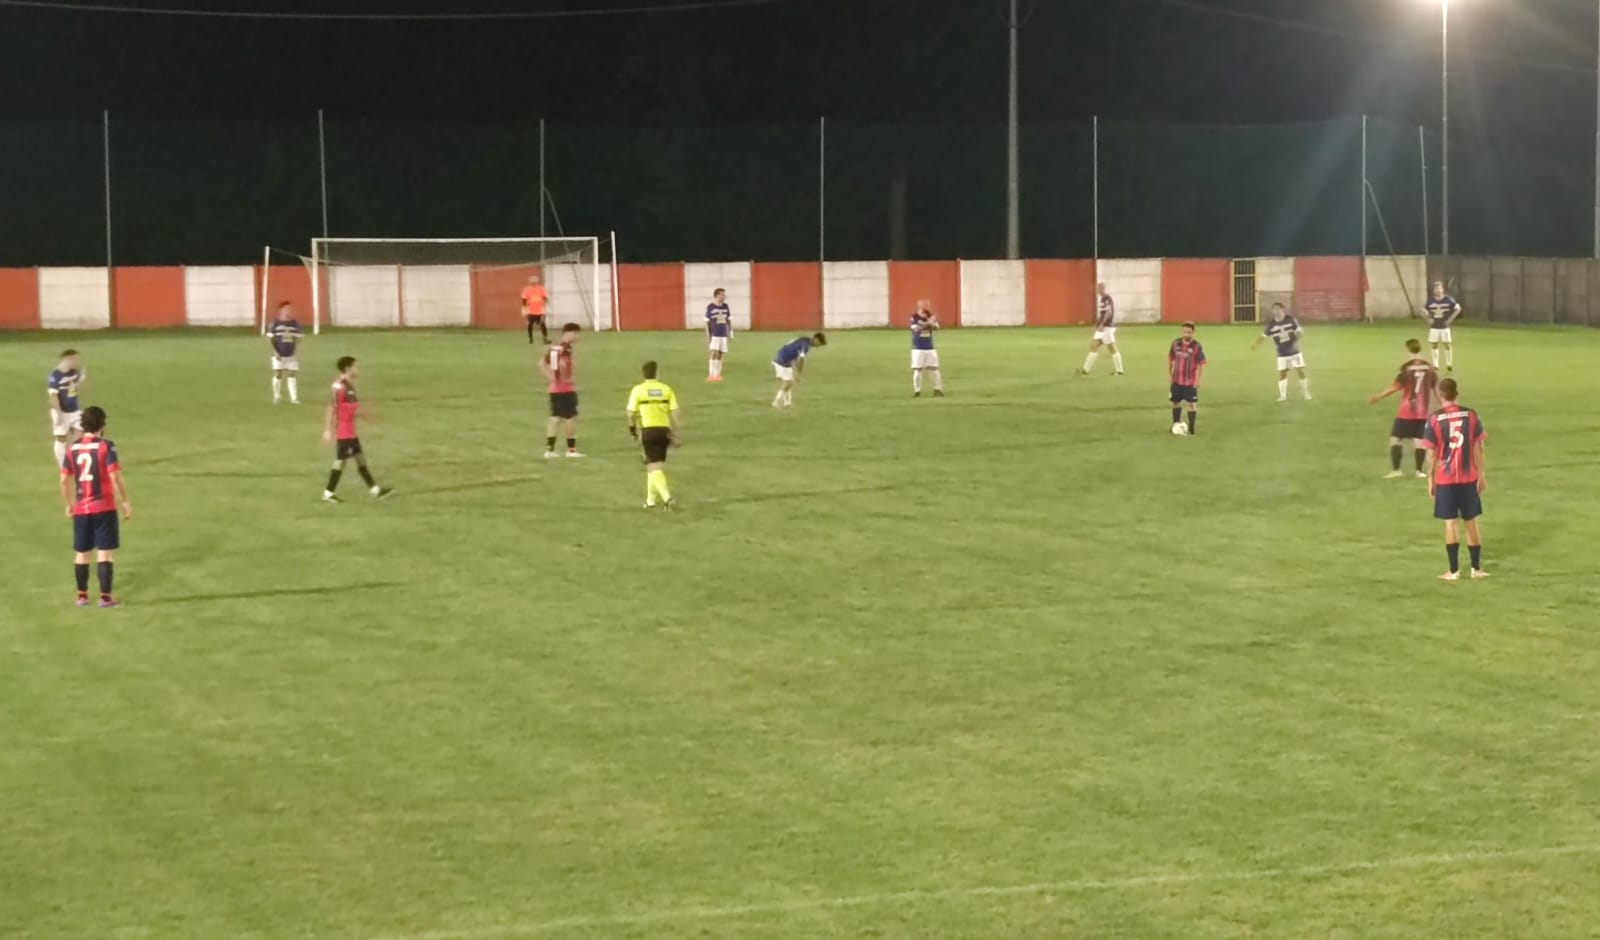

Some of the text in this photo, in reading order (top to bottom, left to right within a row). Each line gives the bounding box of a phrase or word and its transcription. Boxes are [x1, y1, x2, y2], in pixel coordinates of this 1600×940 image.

[1414, 371, 1425, 393] 7
[1449, 420, 1464, 449] 5
[77, 453, 93, 481] 2
